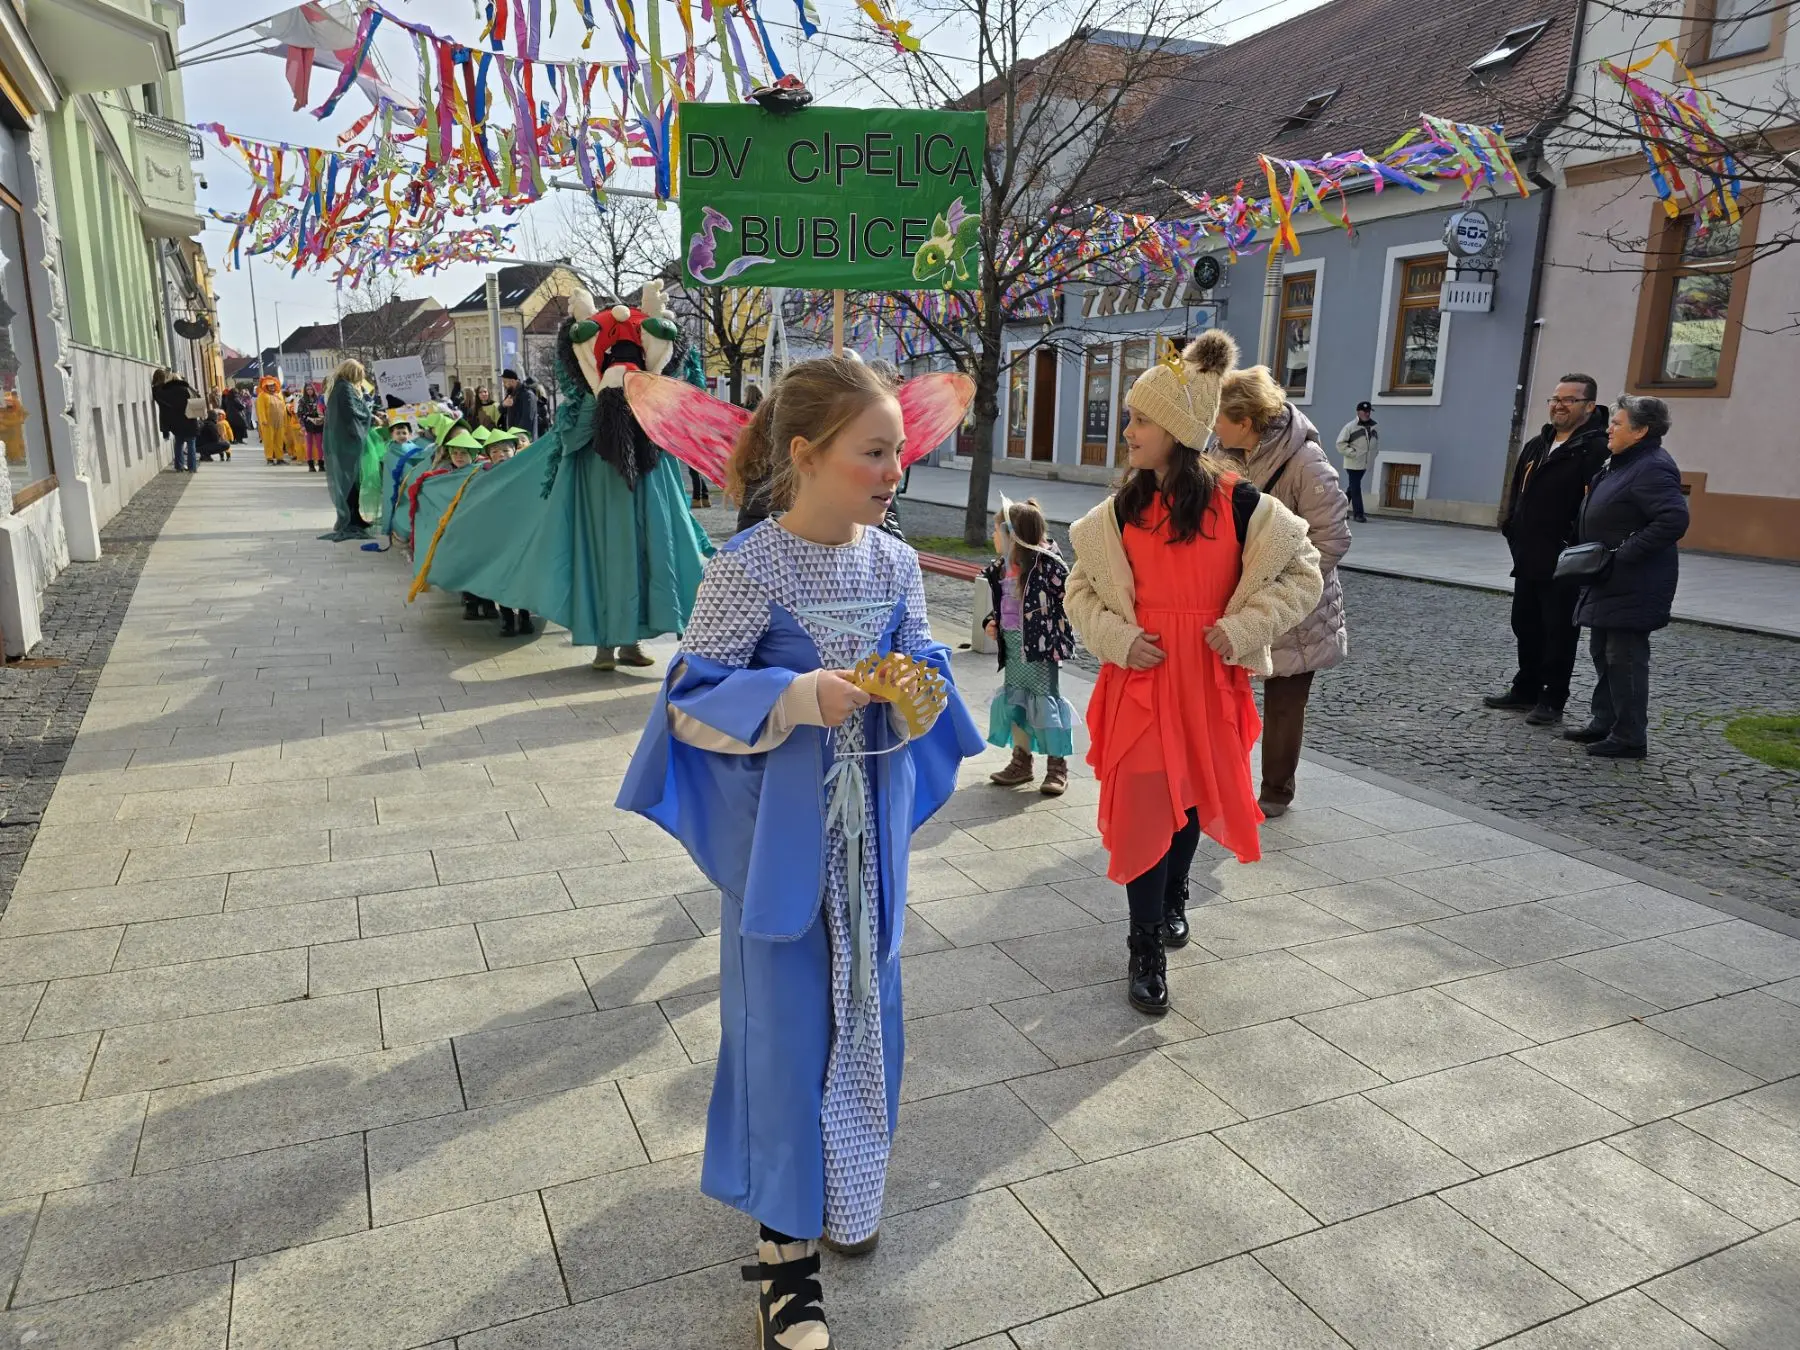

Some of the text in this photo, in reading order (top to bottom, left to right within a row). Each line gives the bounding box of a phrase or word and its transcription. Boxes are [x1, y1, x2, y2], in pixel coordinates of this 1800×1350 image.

[687, 131, 979, 187] DV CIPELICA
[740, 213, 928, 263] BUBICE
[1457, 226, 1489, 239] BOX
[1448, 290, 1490, 304] ABSOLUT
